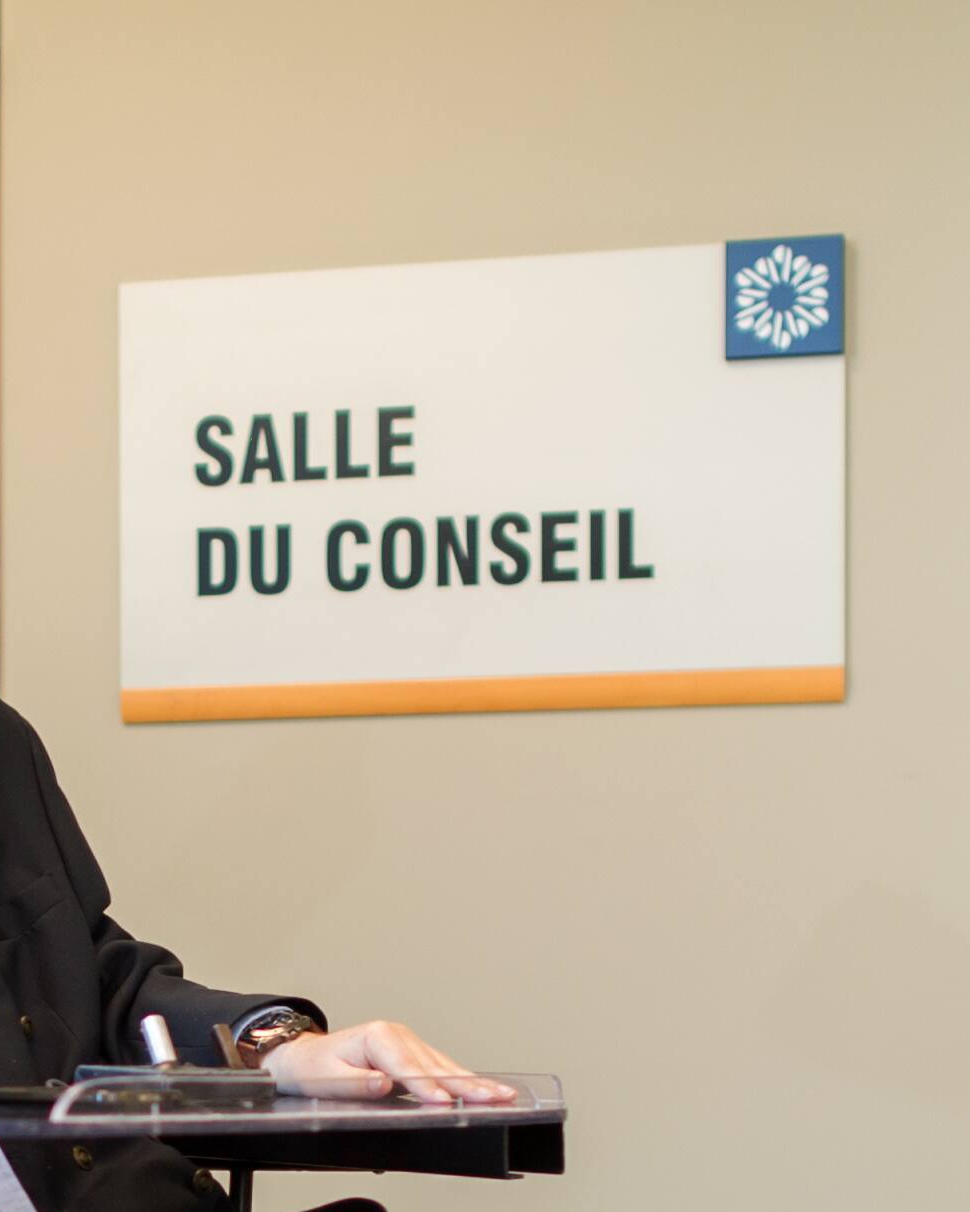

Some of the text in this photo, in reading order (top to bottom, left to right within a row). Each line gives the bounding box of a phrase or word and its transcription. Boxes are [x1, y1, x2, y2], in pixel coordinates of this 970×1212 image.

[194, 405, 416, 488] SALLE
[196, 508, 655, 597] DU CONSEIL
